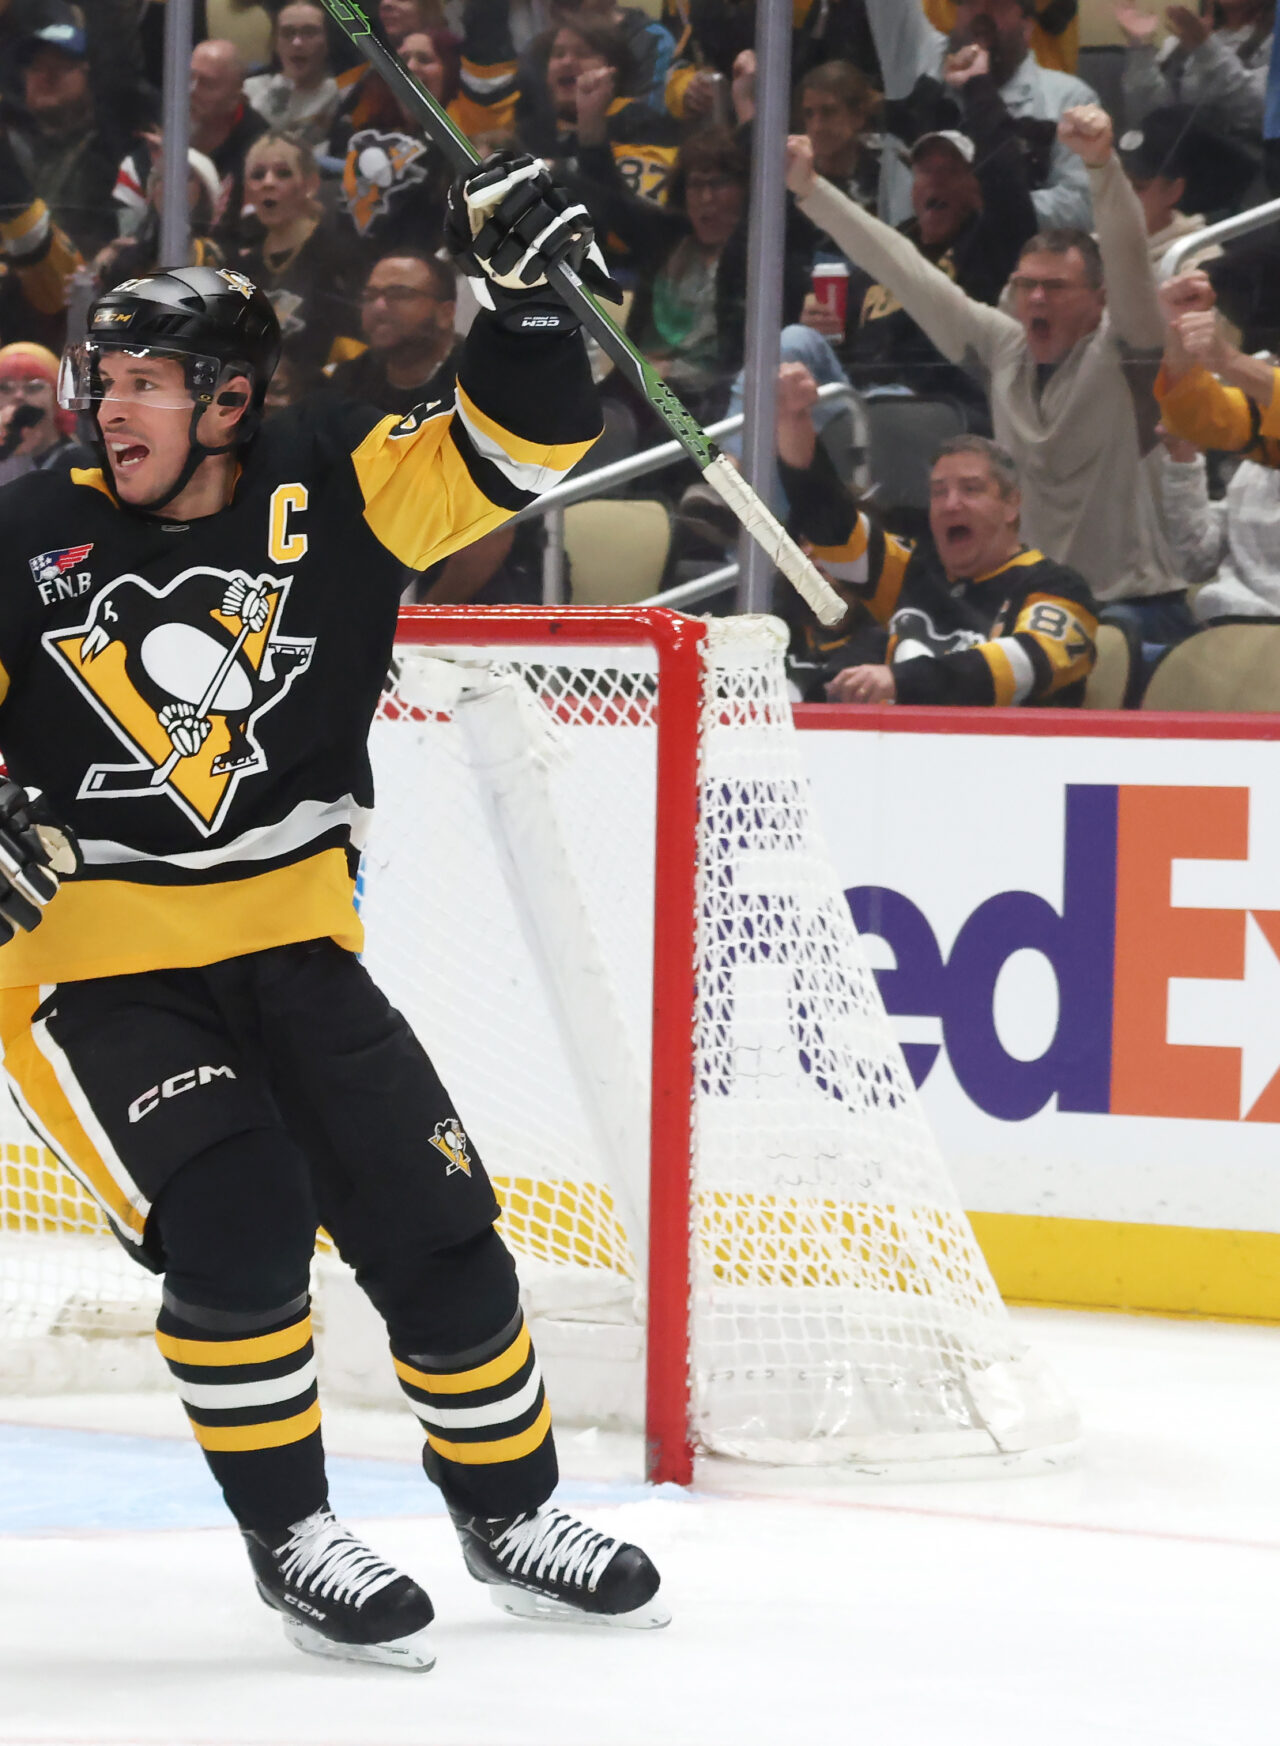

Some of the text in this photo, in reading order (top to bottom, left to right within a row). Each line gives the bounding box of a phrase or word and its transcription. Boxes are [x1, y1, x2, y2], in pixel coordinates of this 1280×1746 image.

[94, 313, 132, 324] CCM
[521, 319, 560, 327] CCM
[269, 482, 309, 565] C
[1029, 601, 1098, 662] 87
[128, 1064, 237, 1123] CCM
[283, 1593, 327, 1621] CCM
